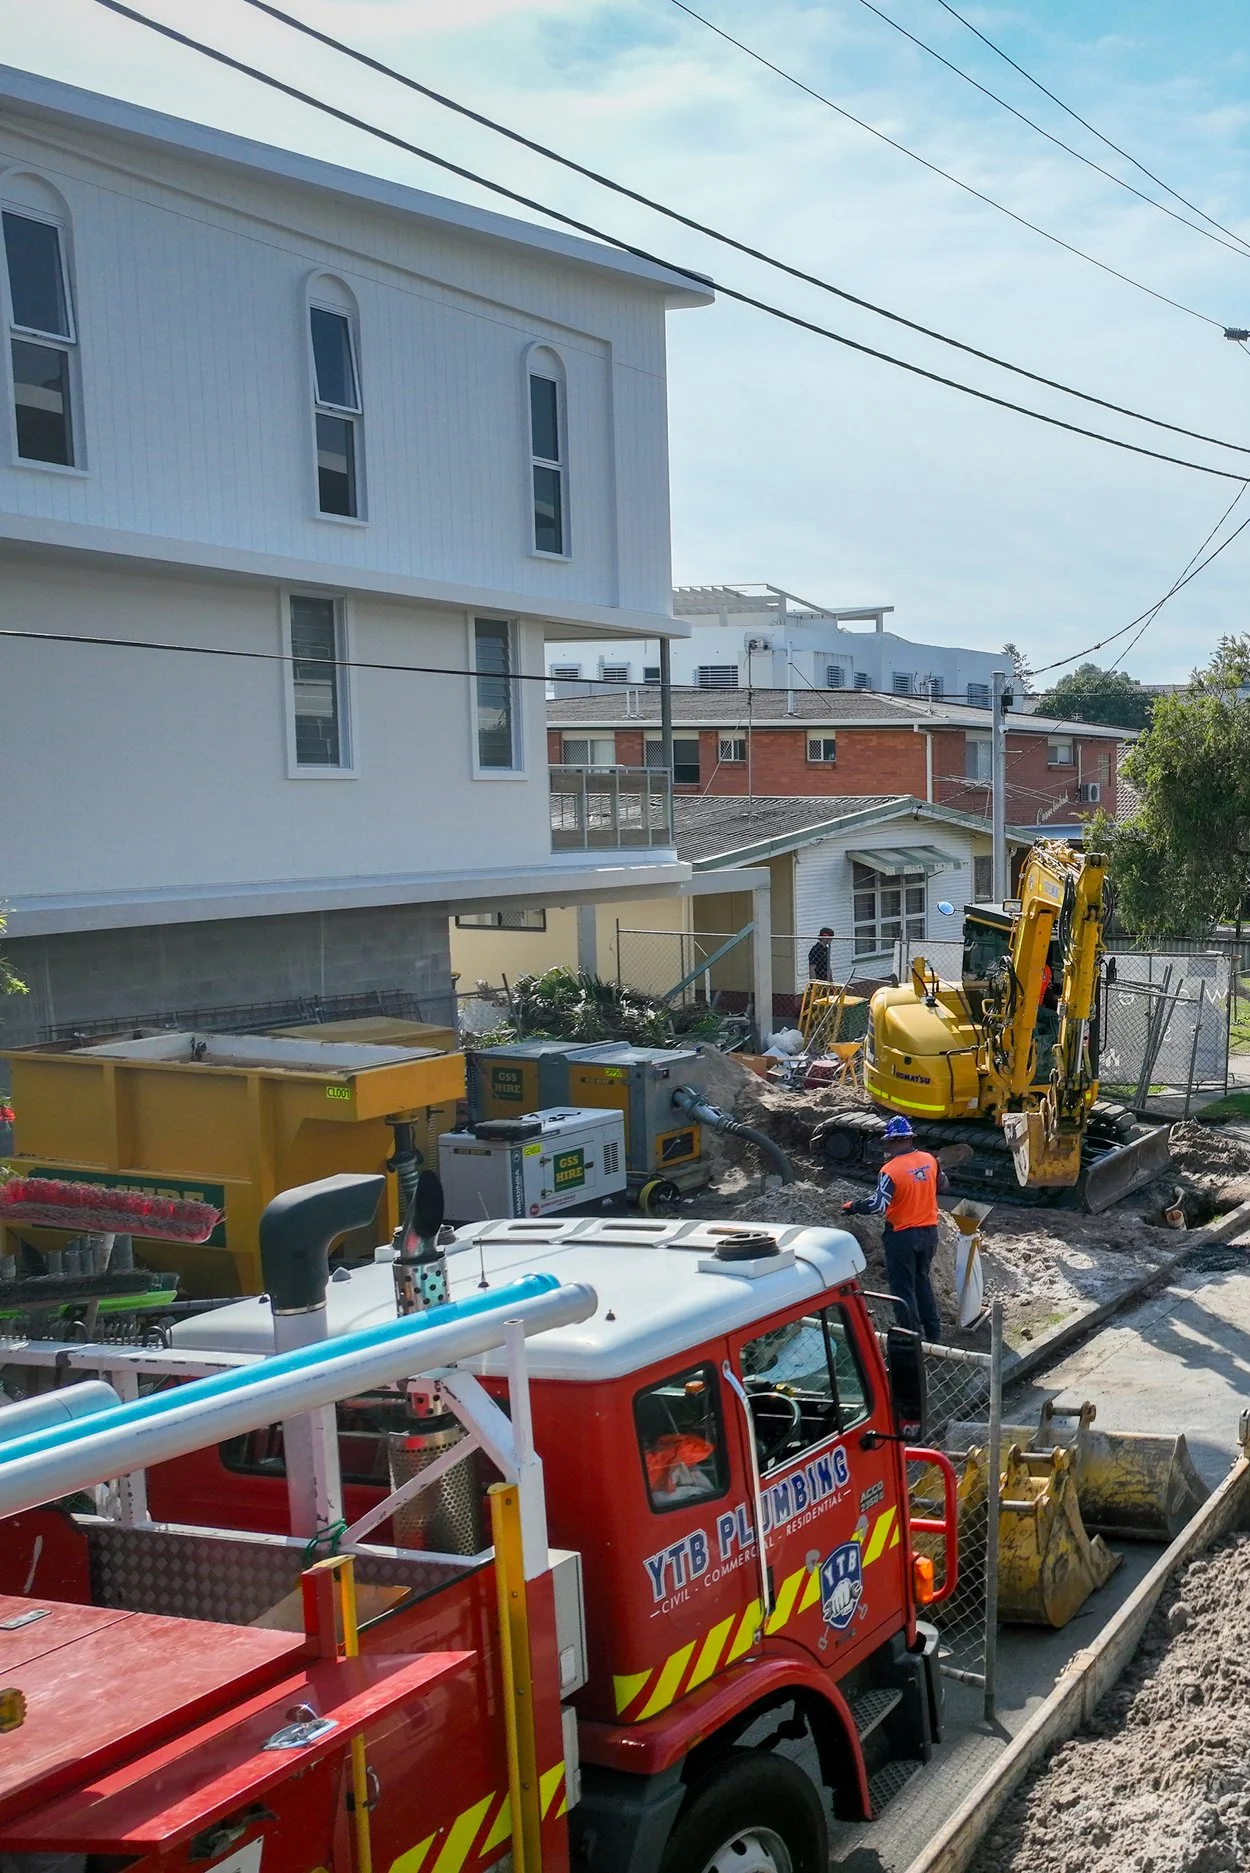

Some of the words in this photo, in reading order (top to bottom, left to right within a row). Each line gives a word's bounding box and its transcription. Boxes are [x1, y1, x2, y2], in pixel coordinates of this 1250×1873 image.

[498, 1071, 517, 1083] GSS
[895, 1071, 931, 1085] KOMATSU
[495, 1083, 521, 1094] HIRE
[559, 1154, 579, 1169] GSS
[556, 1167, 583, 1184] HIRE
[860, 1480, 884, 1502] ACCO
[643, 1528, 710, 1603] YTB
[716, 1444, 850, 1562] PLUMBING
[661, 1589, 690, 1614] CIVIL
[703, 1535, 775, 1587] COMMERCAL
[786, 1492, 843, 1536] RESIDENTIAL
[824, 1549, 857, 1587] YTB
